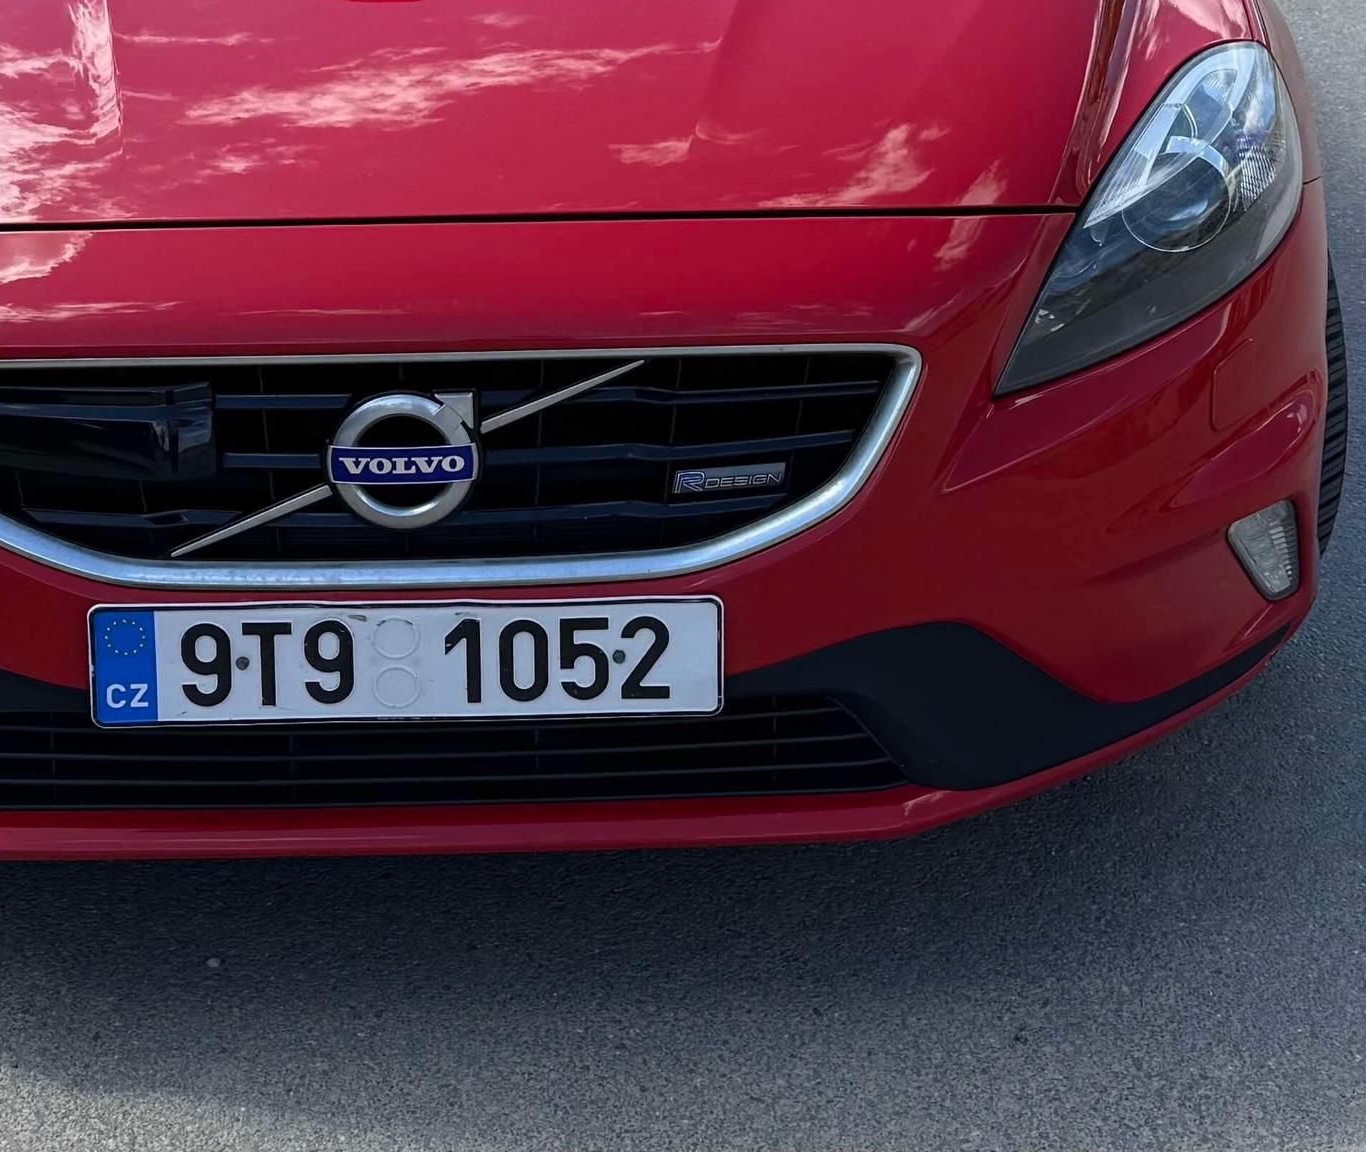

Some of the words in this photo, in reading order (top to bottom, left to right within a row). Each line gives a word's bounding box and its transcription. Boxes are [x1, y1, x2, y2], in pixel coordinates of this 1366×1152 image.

[338, 455, 465, 475] VOLVO
[105, 683, 150, 709] CZ
[180, 619, 355, 707] 9T9
[444, 616, 671, 703] 1052
